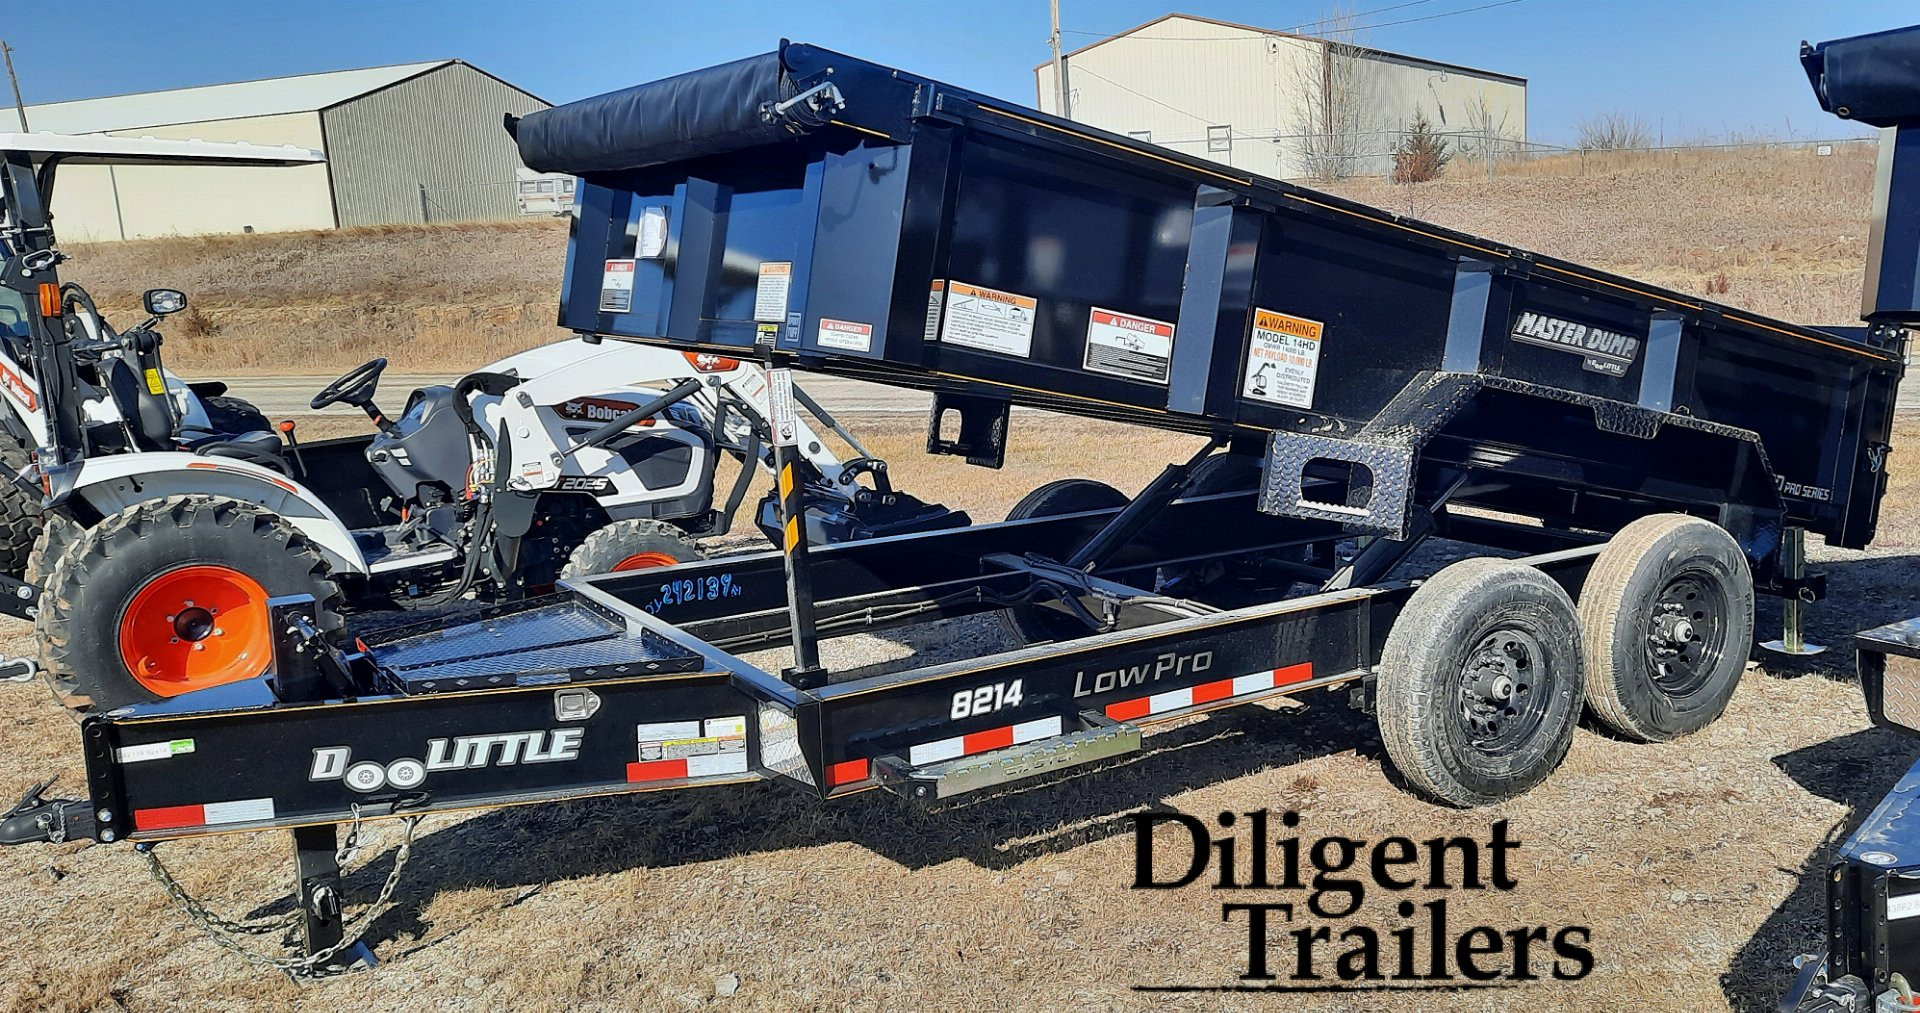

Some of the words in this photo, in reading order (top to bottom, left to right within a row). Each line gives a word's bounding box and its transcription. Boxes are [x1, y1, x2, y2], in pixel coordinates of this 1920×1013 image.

[979, 290, 1017, 305] WARNING
[834, 323, 863, 333] DANGER
[1119, 318, 1156, 334] DANGER
[1268, 316, 1316, 337] WARNING
[1516, 311, 1587, 347] MASTER
[1256, 330, 1290, 345] MODEL
[1293, 339, 1316, 351] 14HD
[1253, 347, 1264, 357] NET
[1264, 350, 1288, 363] PAYLOAD
[587, 404, 632, 420] Bobca
[1784, 482, 1802, 496] PRO
[1802, 485, 1831, 501] SERIES
[1073, 662, 1150, 698] Low
[1154, 650, 1214, 681] Pro
[950, 678, 1024, 720] 8214
